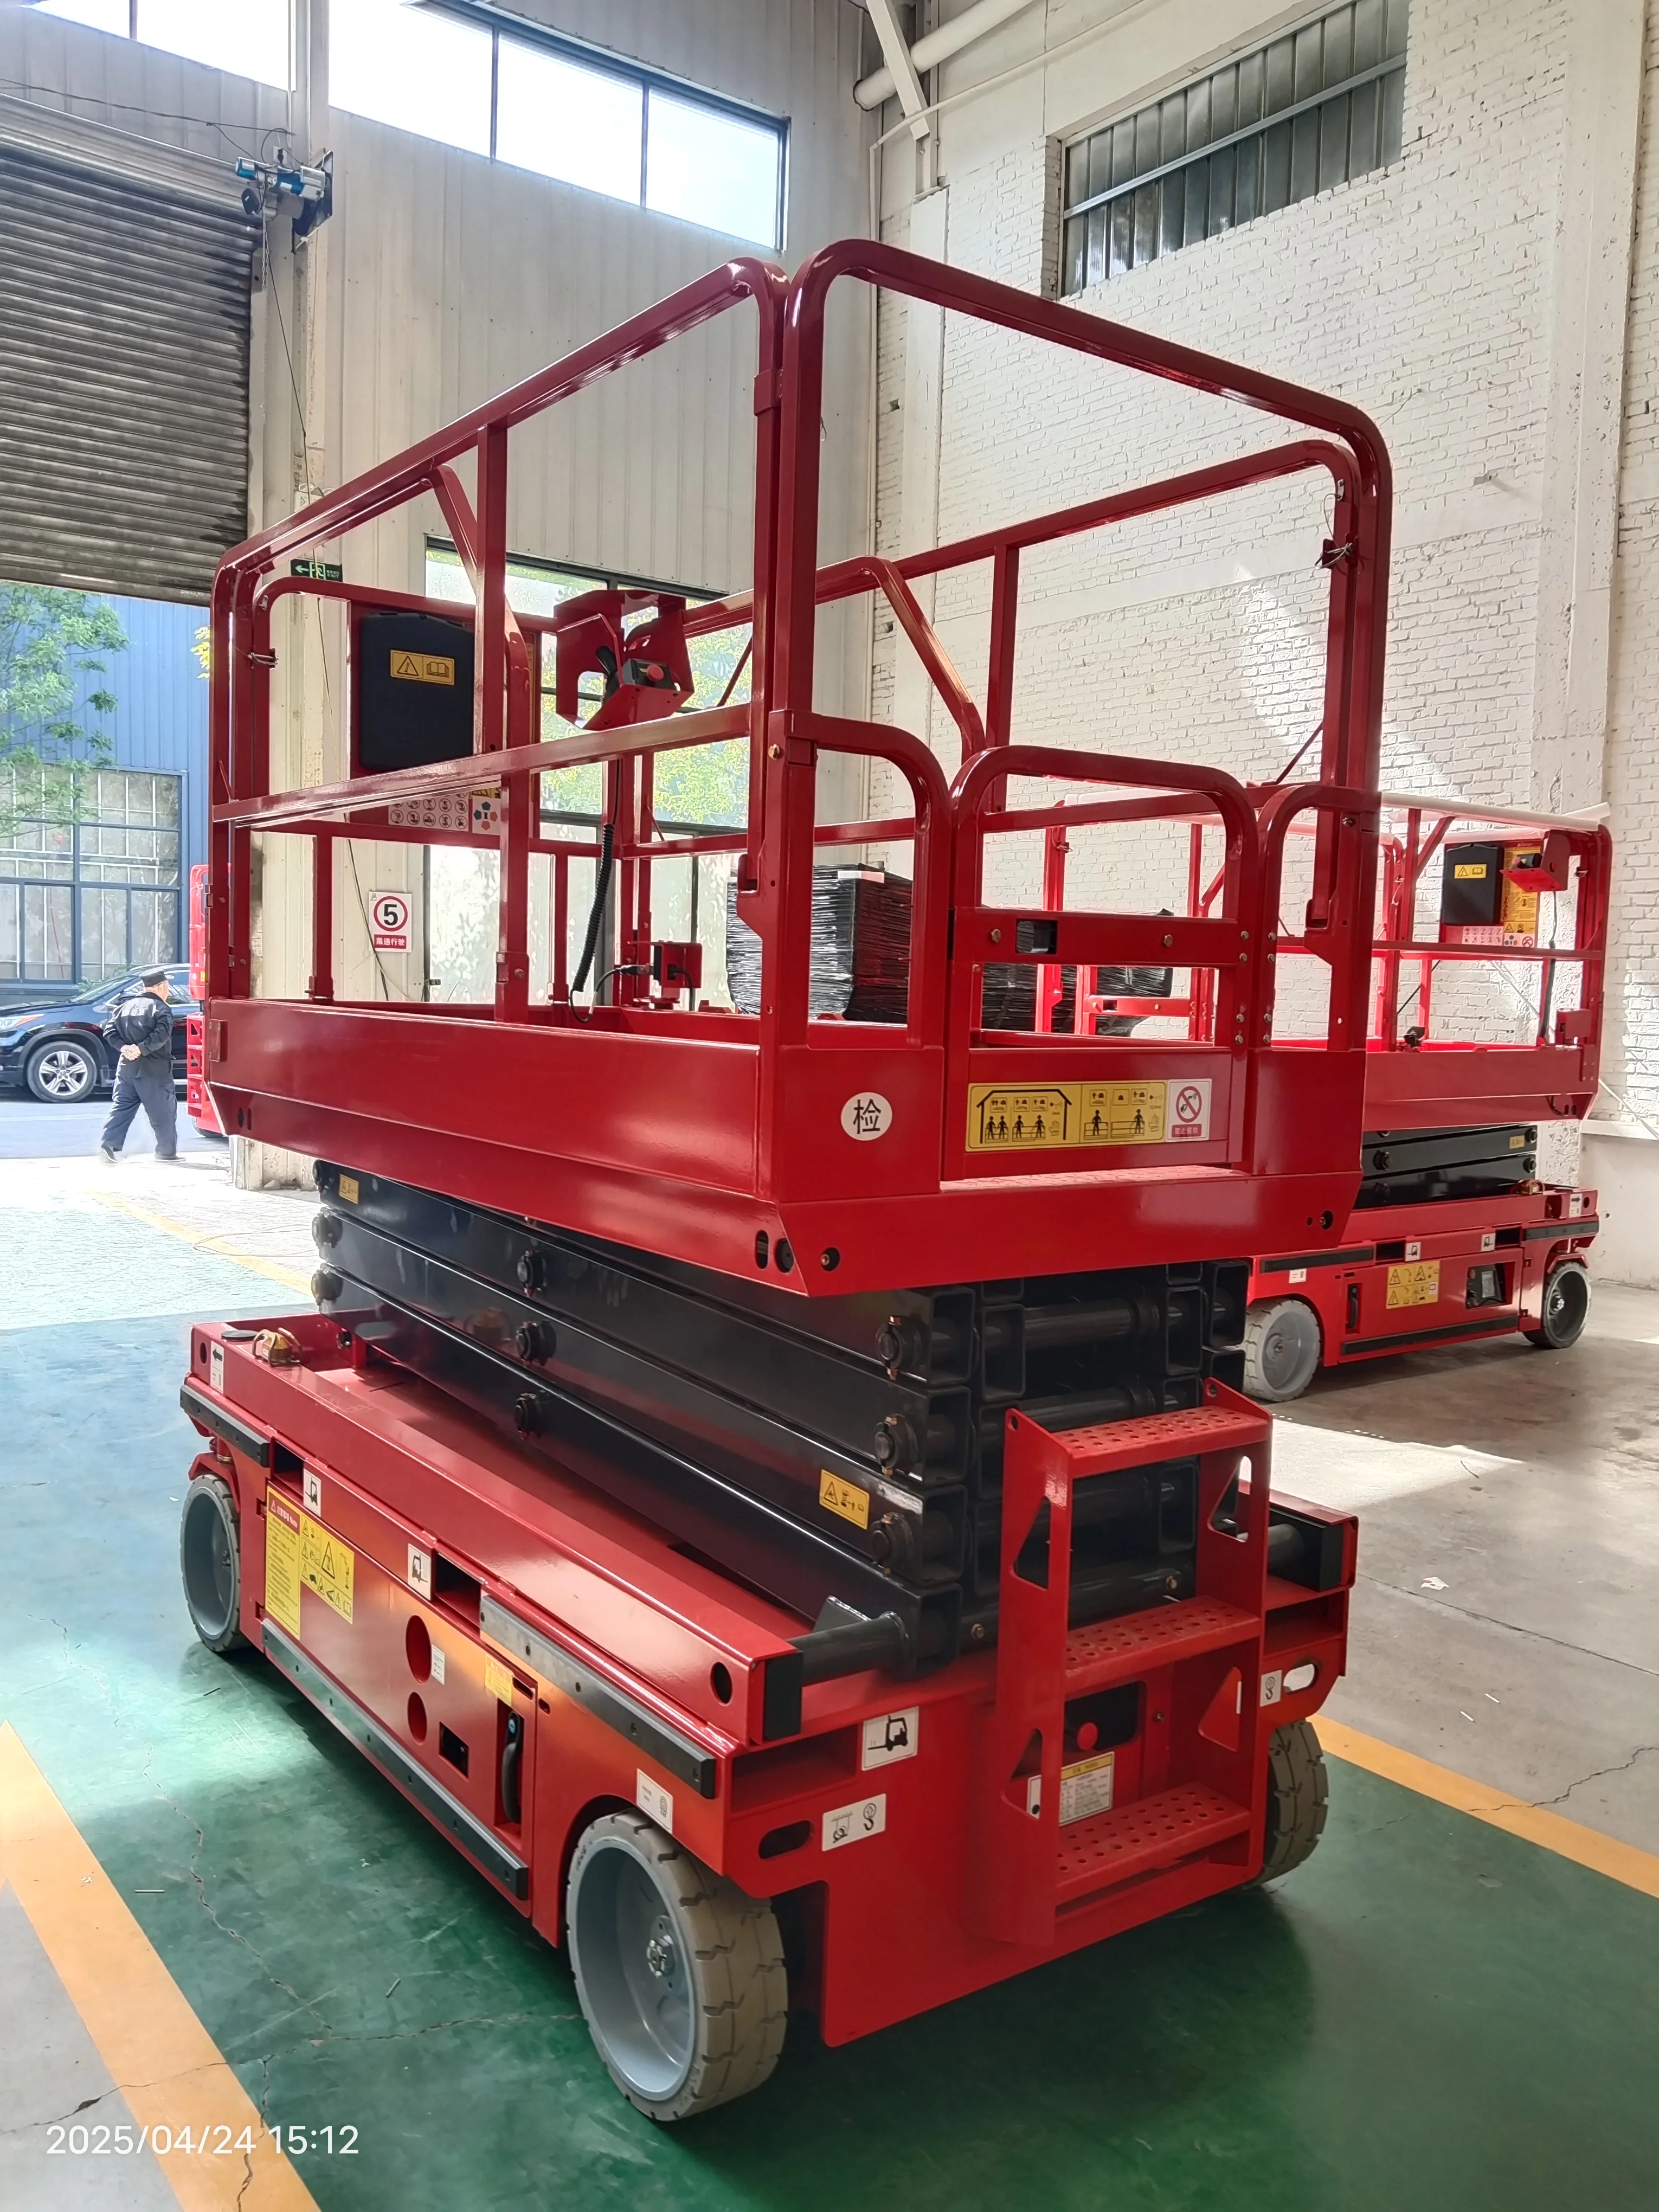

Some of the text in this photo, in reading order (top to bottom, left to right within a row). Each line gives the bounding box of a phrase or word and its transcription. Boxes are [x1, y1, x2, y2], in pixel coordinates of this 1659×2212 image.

[384, 904, 398, 925] 5
[376, 937, 405, 946] 限速行驶
[853, 1098, 882, 1135] 检
